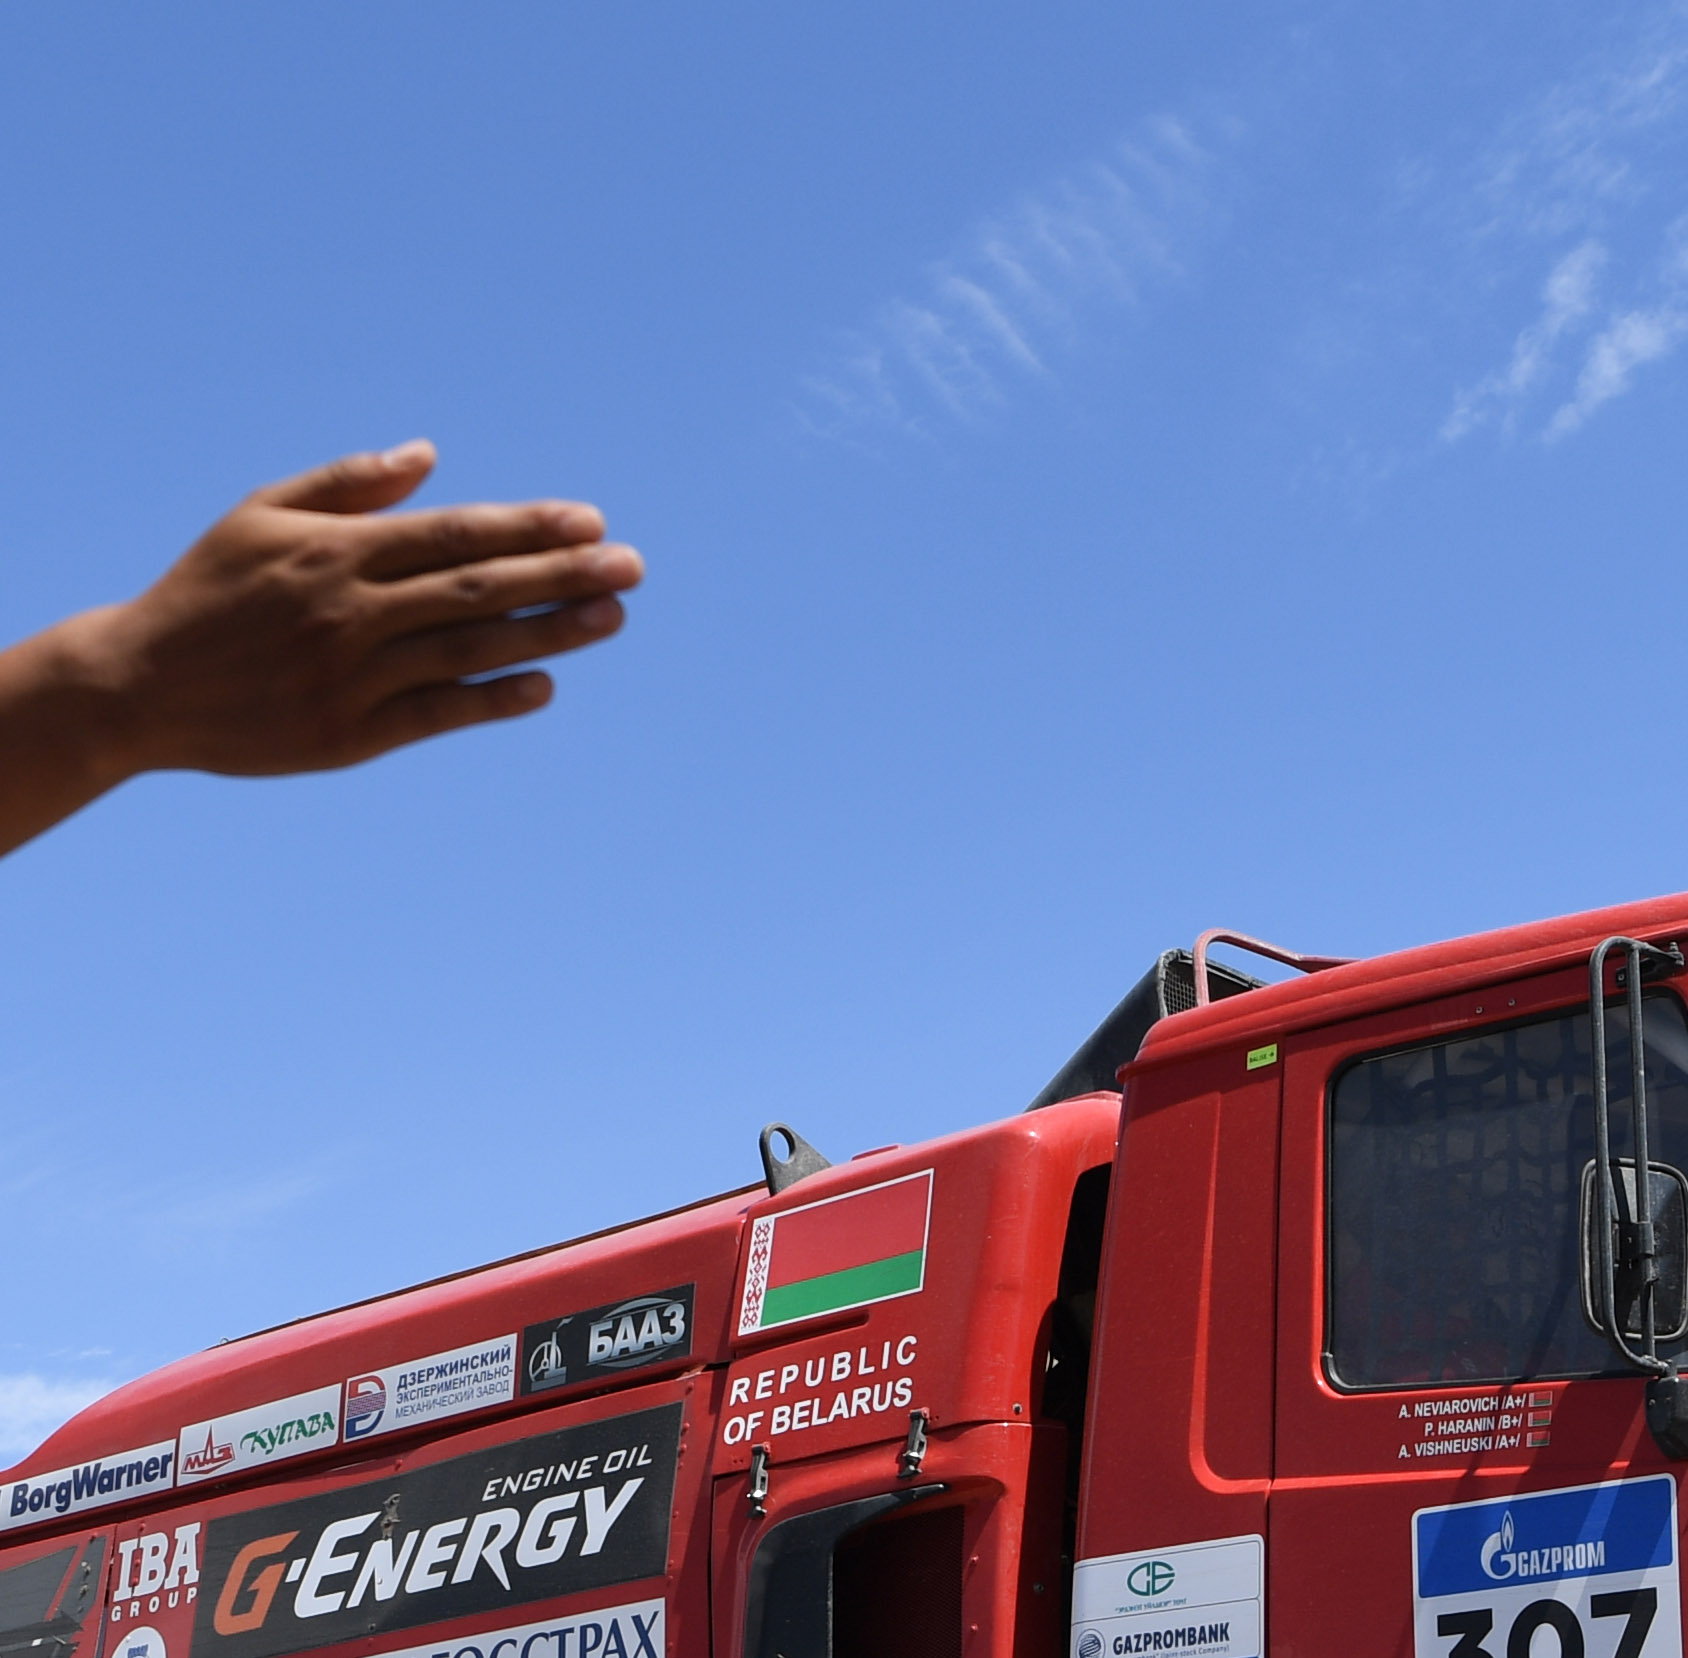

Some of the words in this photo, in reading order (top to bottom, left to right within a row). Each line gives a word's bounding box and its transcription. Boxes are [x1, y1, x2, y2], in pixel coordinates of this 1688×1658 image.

[589, 1303, 685, 1361] БААЗ
[396, 1365, 514, 1404] ЭКСПЕРИМЕНТАЛЬНО-
[397, 1344, 511, 1392] ДЗЕРЖИНСКИЙ
[730, 1336, 917, 1406] REPUBLIC
[395, 1386, 474, 1418] МЕХАНИЧЕСКИЙ
[476, 1380, 509, 1399] ЗАВОД
[723, 1412, 764, 1444] OF
[771, 1377, 912, 1436] BELARUS
[1399, 1405, 1411, 1419] A.
[1415, 1396, 1499, 1417] NEVIAROVICH
[1501, 1393, 1526, 1410] /A+/
[1425, 1422, 1434, 1436] P.
[1438, 1417, 1495, 1436] HARANIN
[1498, 1414, 1523, 1430] /B+/
[1398, 1444, 1411, 1459] A.
[1414, 1436, 1492, 1457] VISHNEUSKI
[1495, 1433, 1521, 1449] /A+/
[10, 1452, 173, 1517] BorgWarner
[482, 1456, 598, 1501] ENGINE
[603, 1444, 653, 1471] OIL
[113, 1522, 201, 1602] IBA
[1517, 1540, 1605, 1577] GAZPROM
[111, 1587, 197, 1622] GROUP
[1113, 1622, 1230, 1655] GAZPROMBANK
